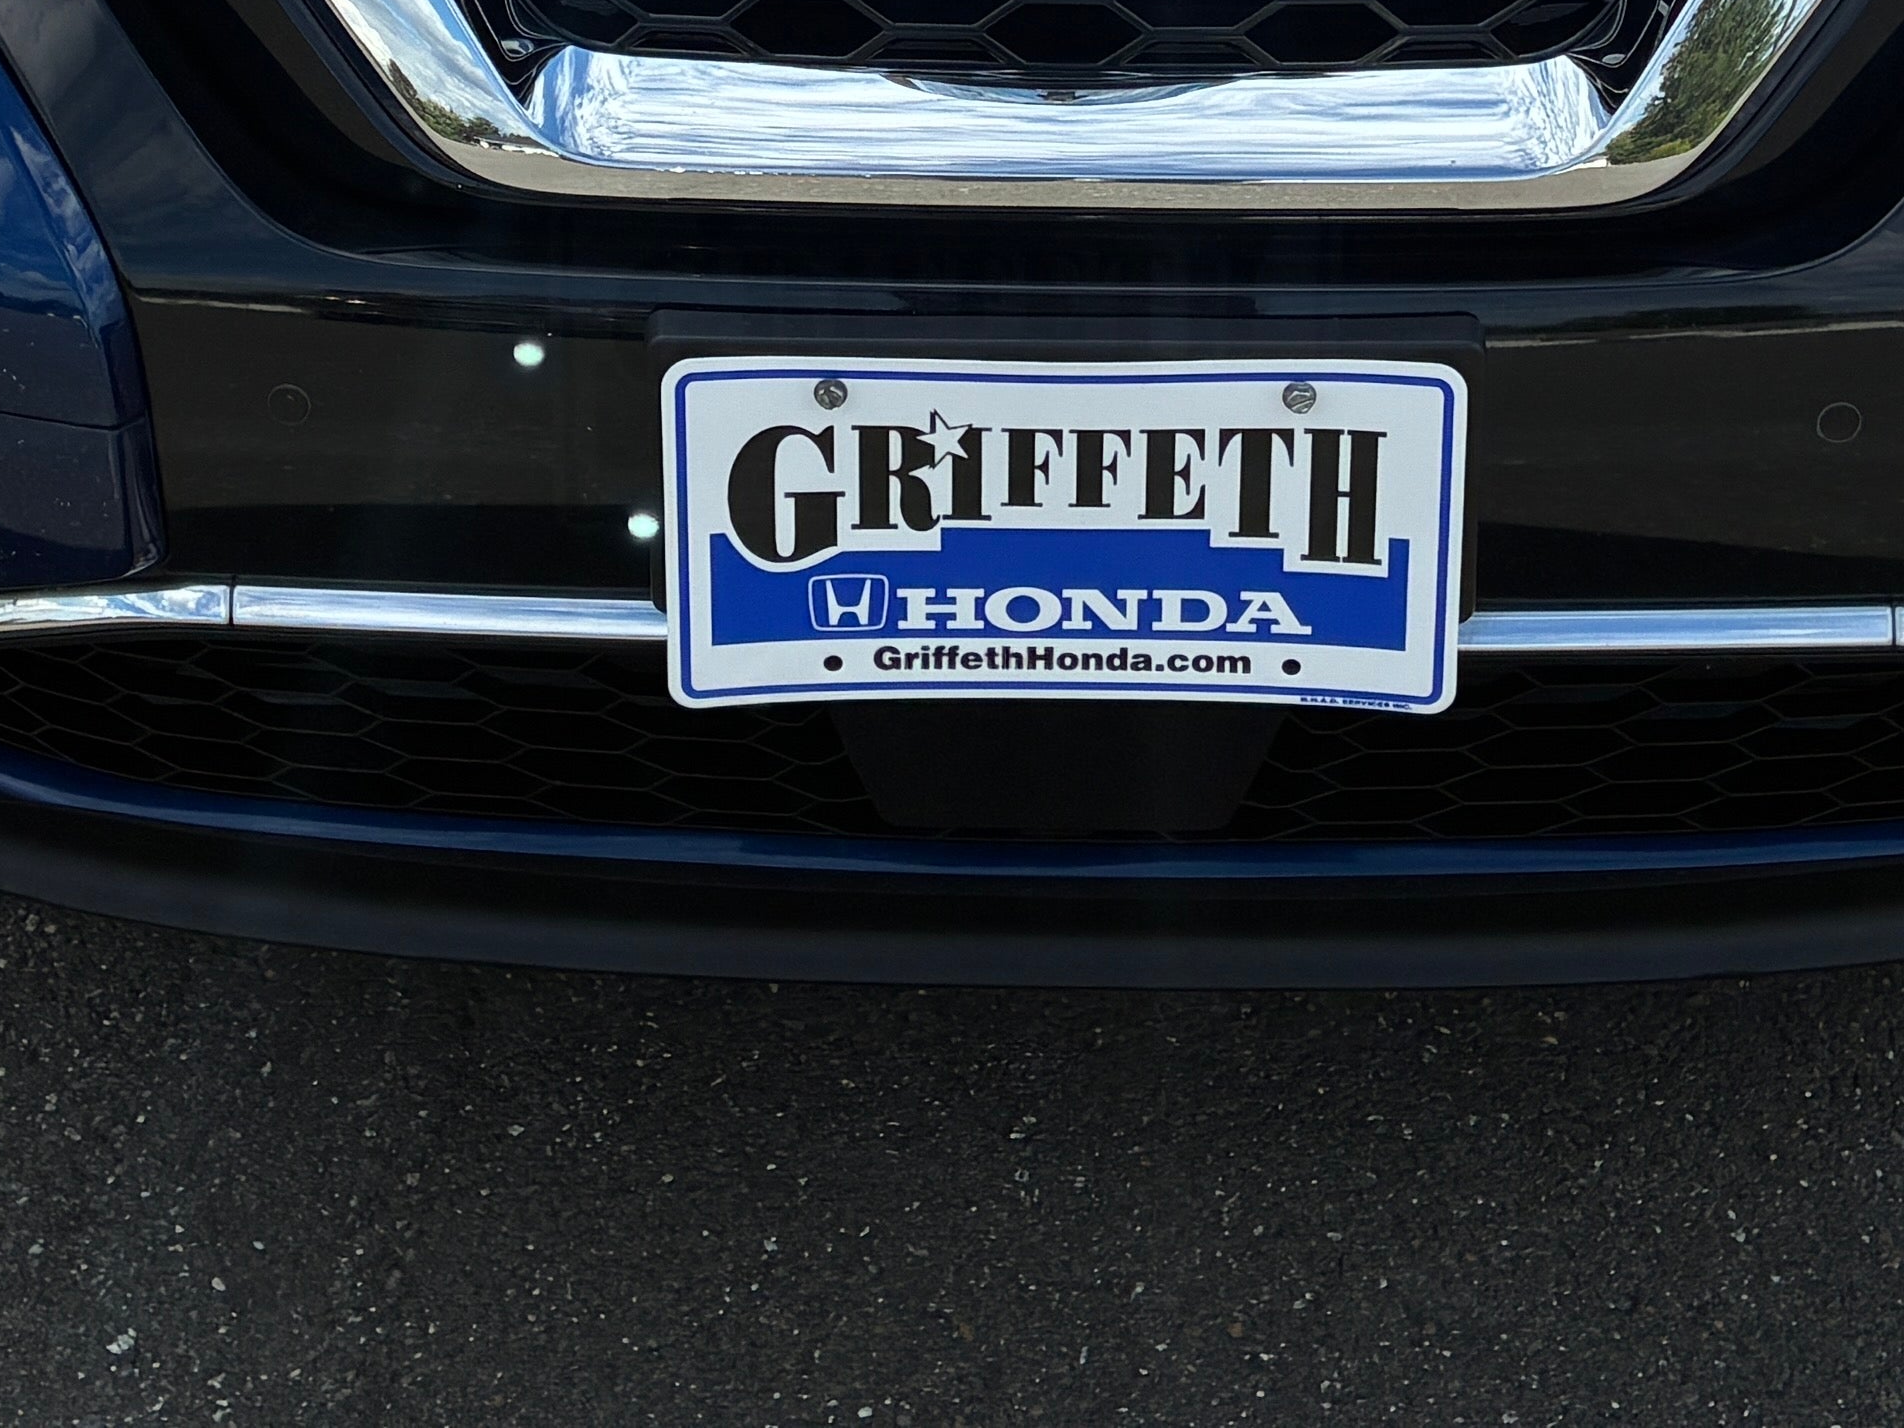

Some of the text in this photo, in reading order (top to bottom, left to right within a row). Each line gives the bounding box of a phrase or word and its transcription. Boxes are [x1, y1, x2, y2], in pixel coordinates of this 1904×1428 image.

[727, 424, 1387, 565] GRIFFETH
[896, 586, 1312, 636] HONDA
[872, 644, 1253, 676] GriffethHonda.com
